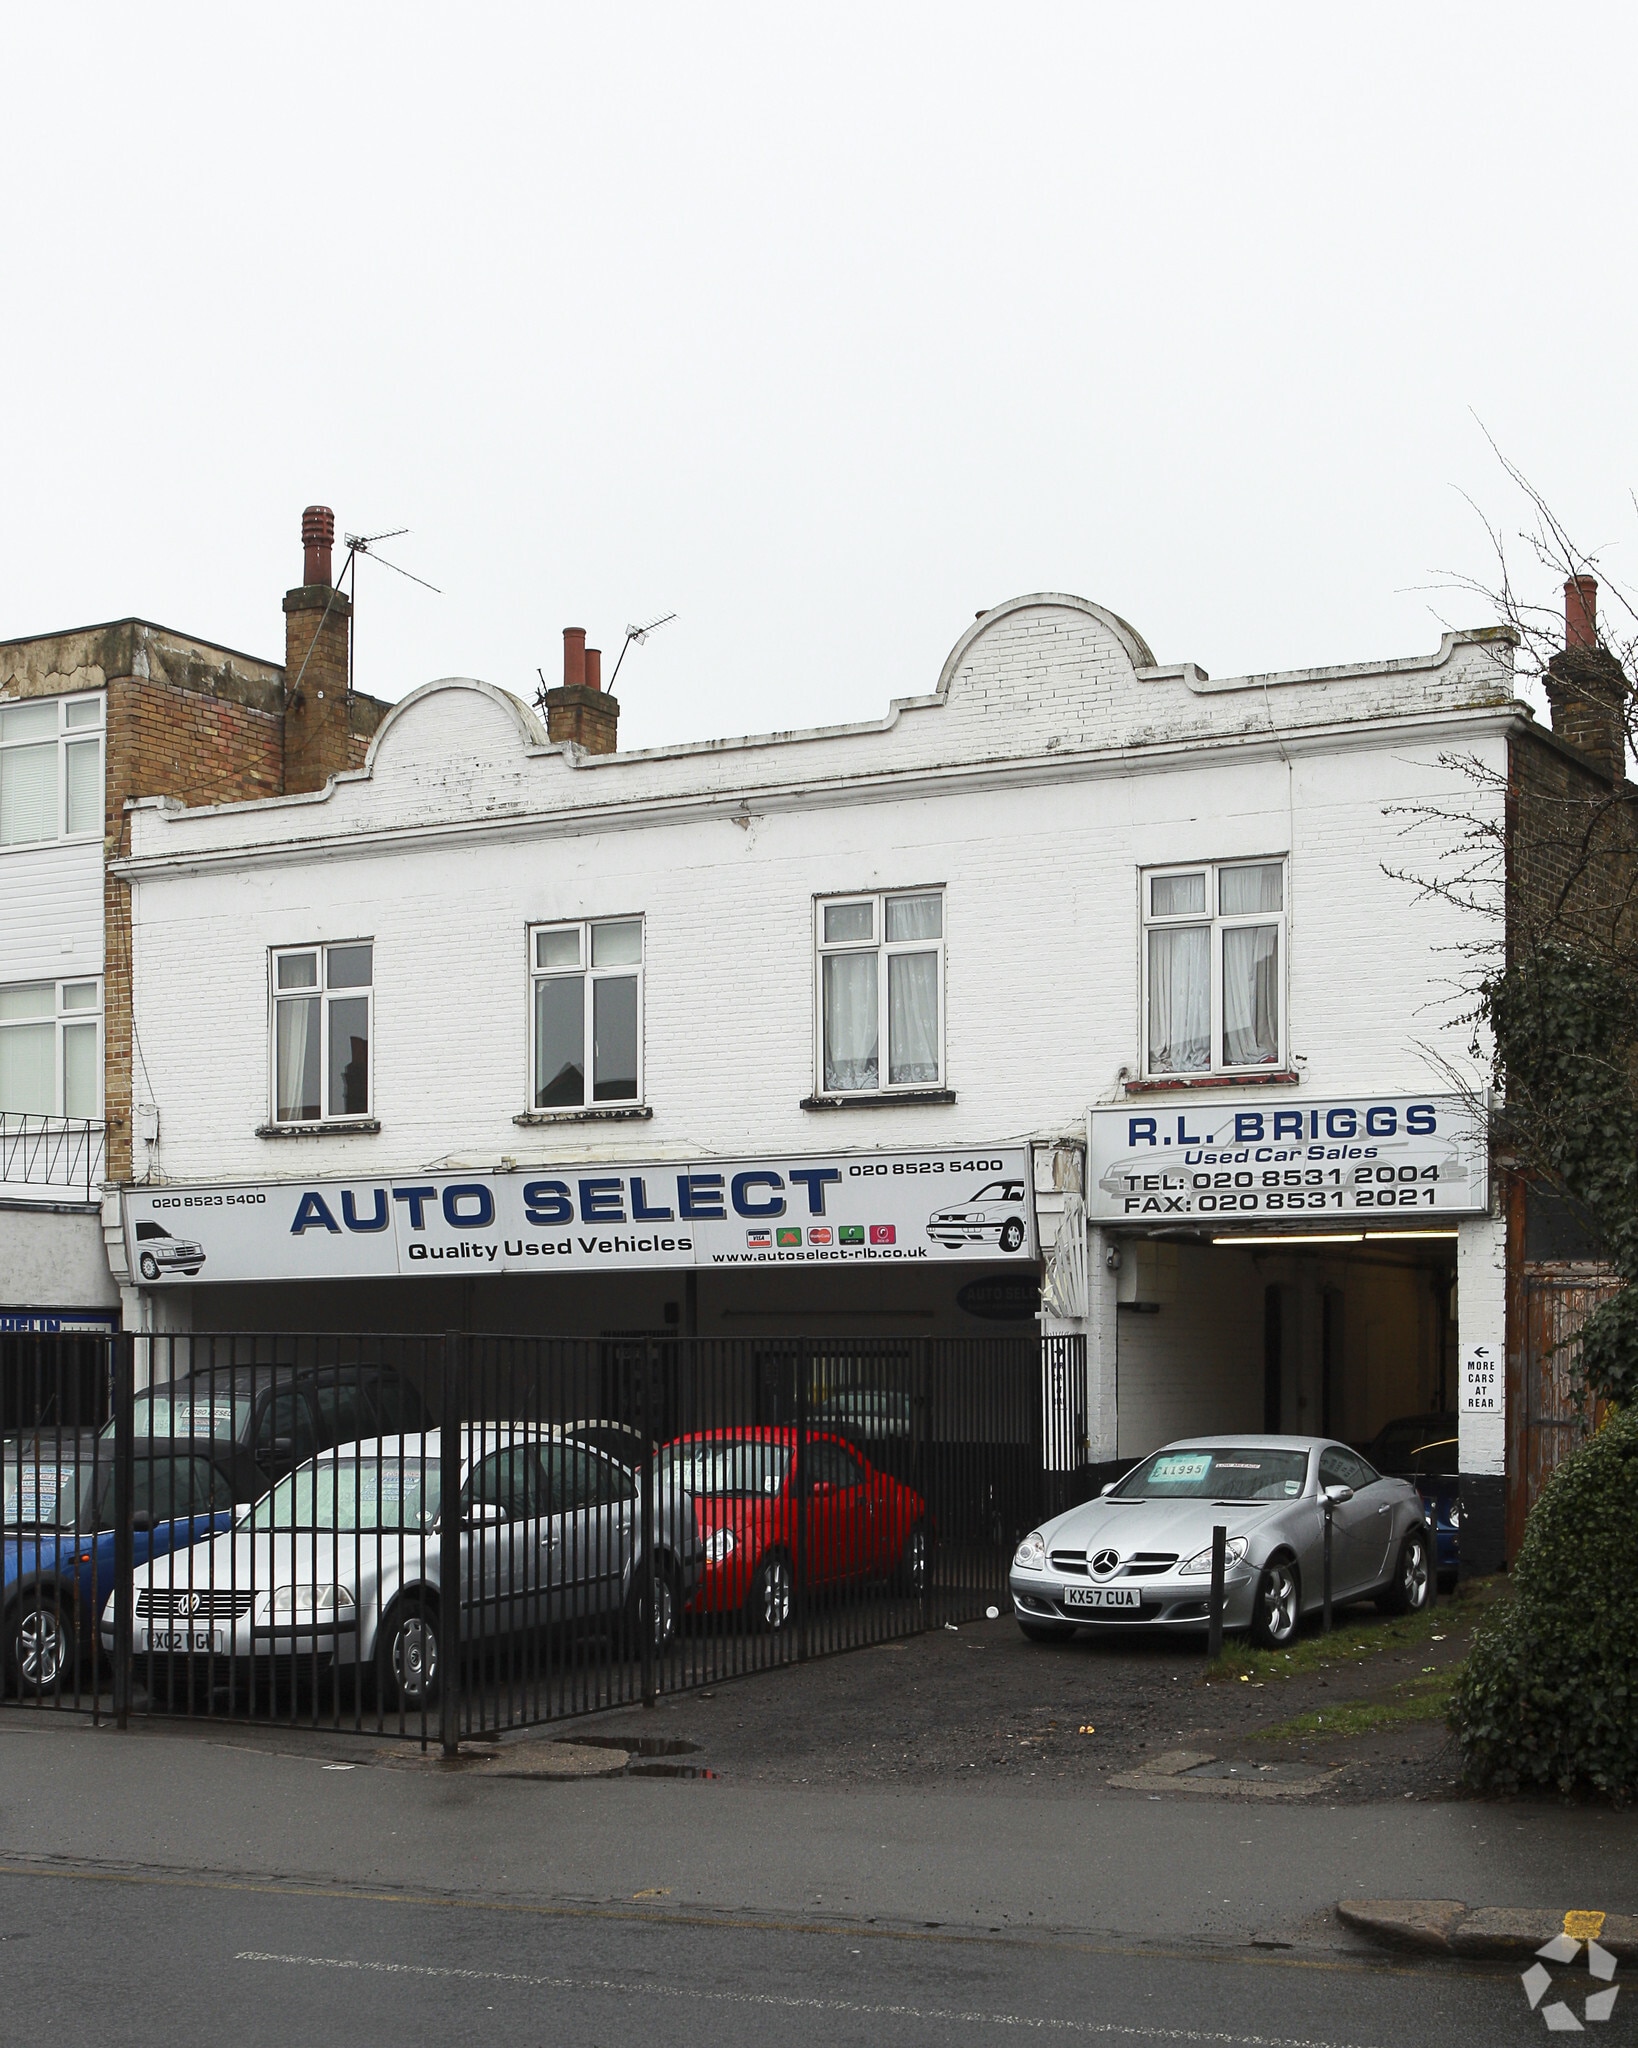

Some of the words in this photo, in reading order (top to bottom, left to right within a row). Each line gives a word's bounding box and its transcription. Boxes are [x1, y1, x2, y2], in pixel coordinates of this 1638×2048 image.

[1128, 1114, 1214, 1147] R.L.
[1234, 1104, 1437, 1142] BRIGGS
[1184, 1148, 1247, 1166] Used
[1255, 1147, 1303, 1163] Car
[1307, 1144, 1379, 1162] Sales
[849, 1164, 888, 1177] 020
[892, 1161, 945, 1175] 8523
[949, 1159, 1003, 1173] 5400
[1123, 1174, 1184, 1192] TEL:
[1192, 1171, 1253, 1190] 020
[1262, 1168, 1342, 1188] 8531
[1354, 1165, 1441, 1185] 2004
[151, 1197, 181, 1209] 020
[183, 1195, 224, 1208] 8523
[226, 1193, 266, 1205] 5400
[289, 1183, 496, 1236] AUTO
[522, 1167, 842, 1227] SELECT
[1124, 1196, 1192, 1215] FAX:
[1198, 1194, 1259, 1213] 020
[1265, 1191, 1344, 1211] 8531
[1355, 1188, 1436, 1208] 2021
[408, 1241, 498, 1262] Quality
[504, 1237, 572, 1258] Used
[577, 1233, 693, 1255] Vehicles
[712, 1247, 928, 1263] www.autoselect-rlb.co.uk
[1467, 1361, 1495, 1371] MORE
[1468, 1373, 1494, 1384] CARS
[1475, 1386, 1487, 1396] AT
[1468, 1398, 1494, 1408] REAR
[1069, 1589, 1102, 1605] KX57
[1106, 1591, 1134, 1605] CUA
